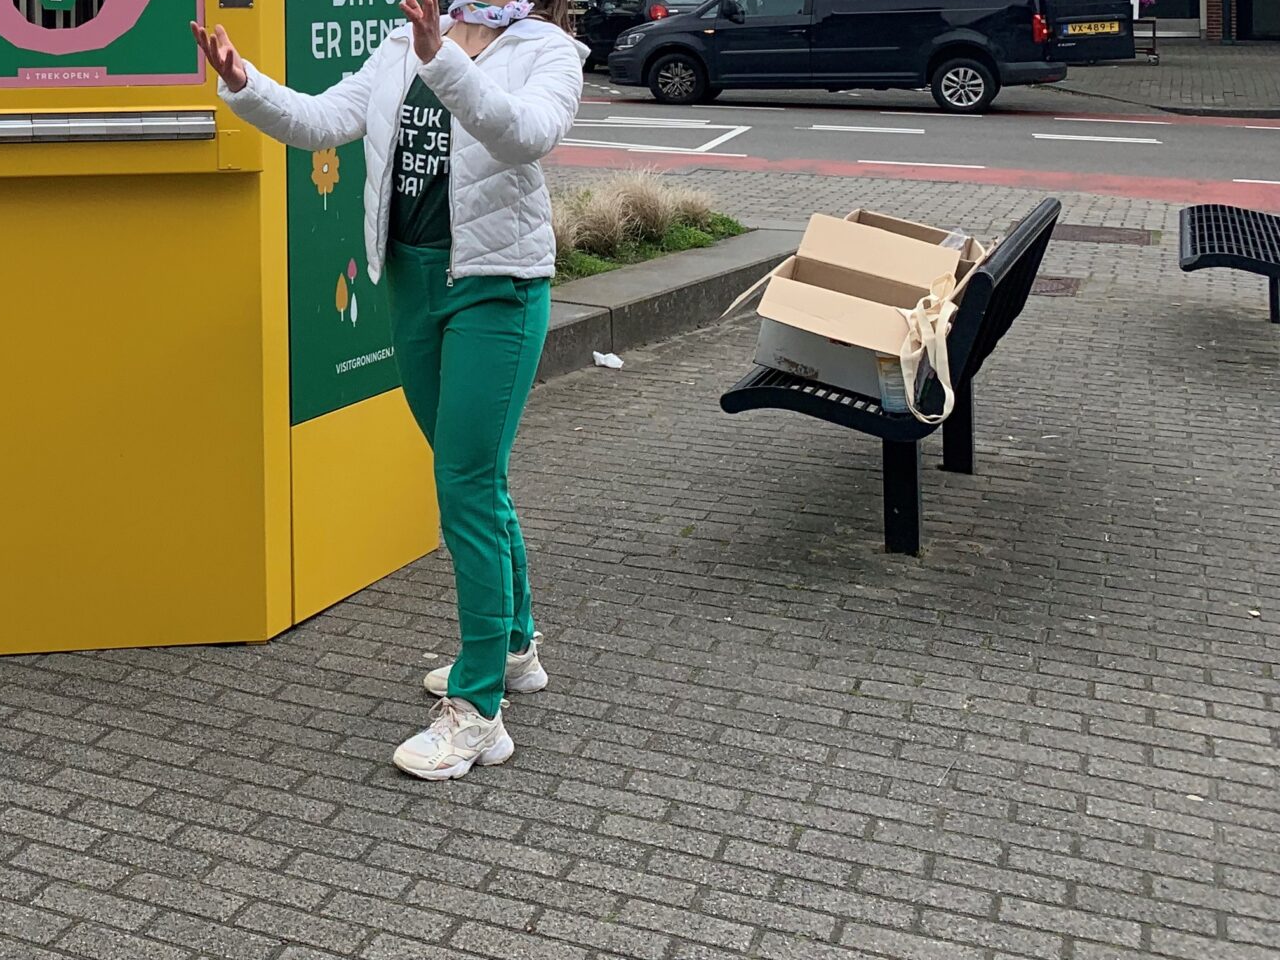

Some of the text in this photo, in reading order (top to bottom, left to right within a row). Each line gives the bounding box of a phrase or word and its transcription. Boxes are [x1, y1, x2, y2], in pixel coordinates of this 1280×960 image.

[311, 21, 342, 59] ER
[35, 71, 90, 80] TREK OPEN
[423, 132, 449, 152] JE
[402, 151, 451, 176] BENT
